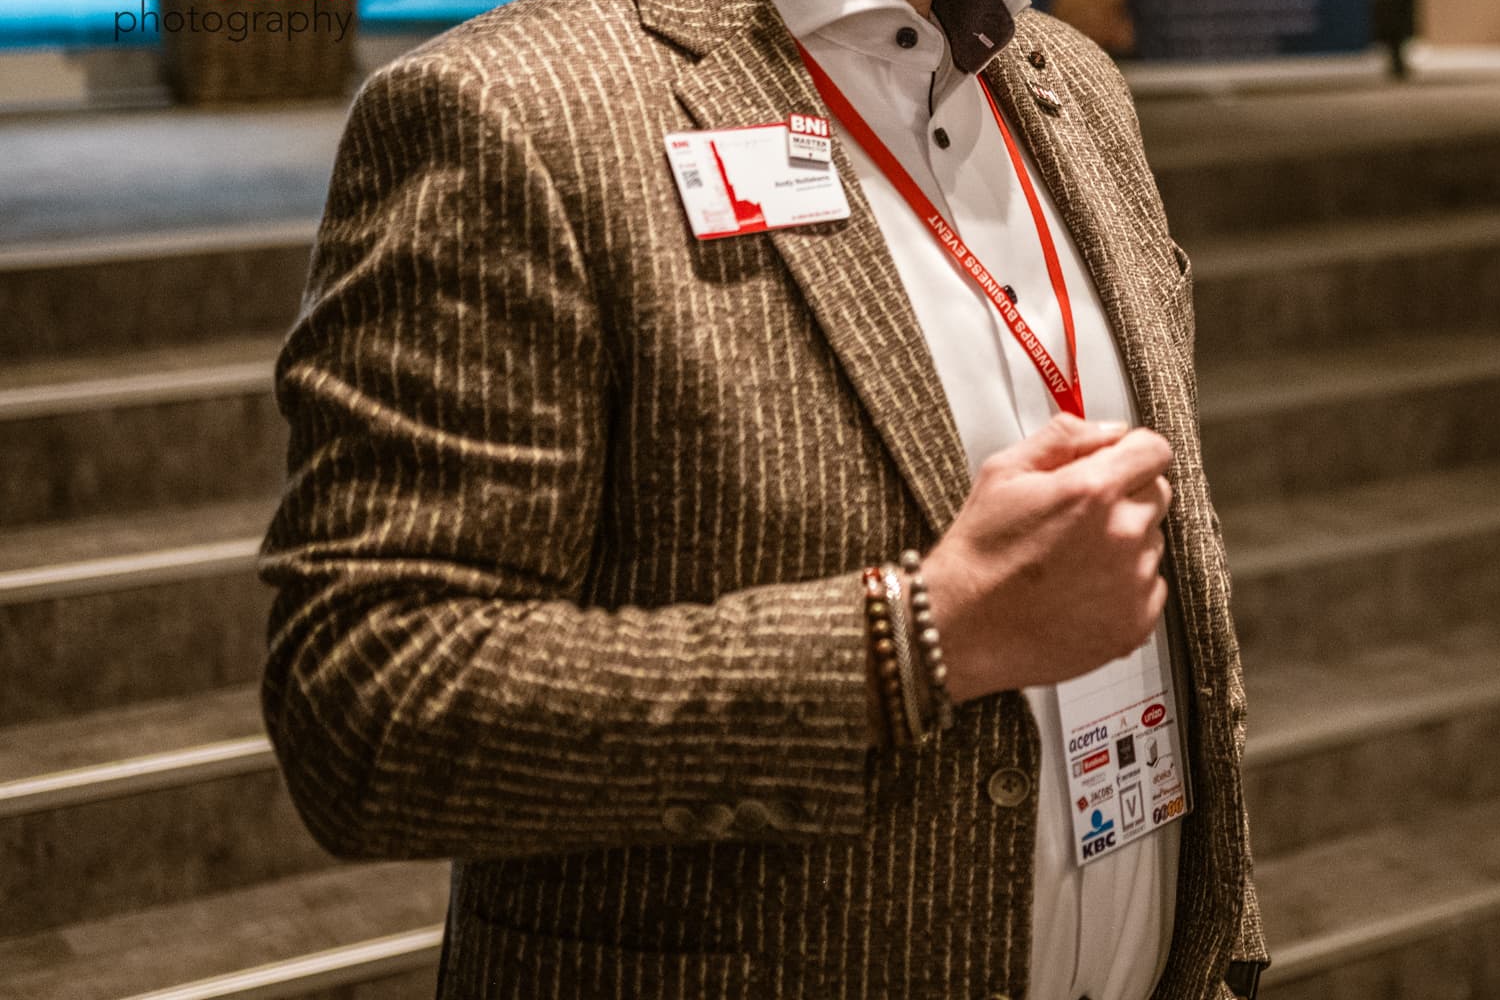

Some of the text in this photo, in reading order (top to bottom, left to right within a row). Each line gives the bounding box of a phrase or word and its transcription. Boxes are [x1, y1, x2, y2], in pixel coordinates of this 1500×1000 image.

[927, 214, 1067, 394] ANTWERPS BUSINESS EVENT
[1068, 725, 1109, 754] acerta
[1089, 784, 1114, 802] JACOBS
[1081, 831, 1117, 861] KBC
